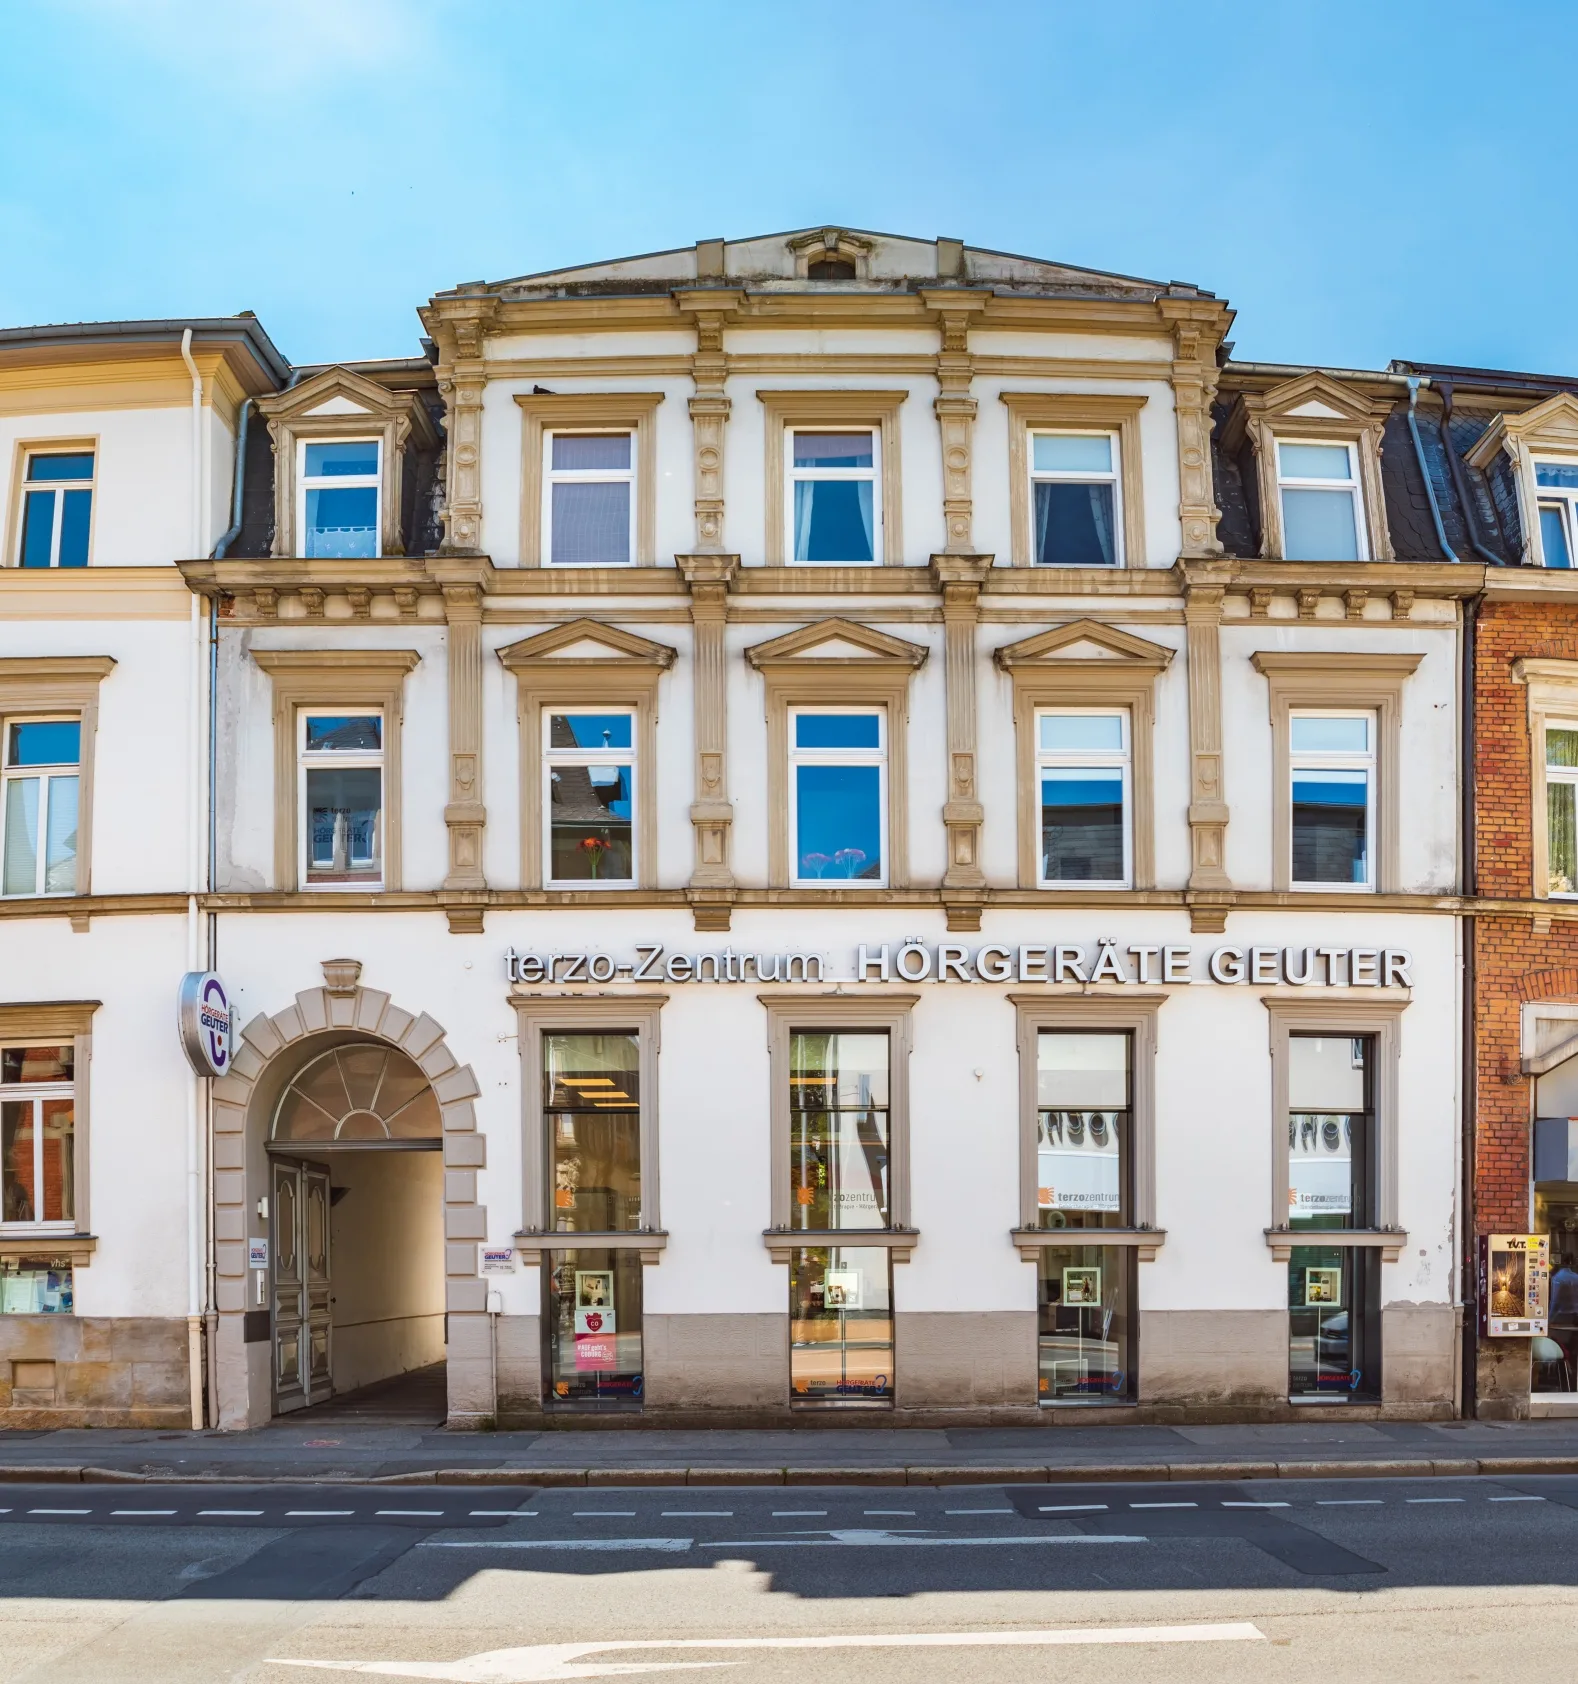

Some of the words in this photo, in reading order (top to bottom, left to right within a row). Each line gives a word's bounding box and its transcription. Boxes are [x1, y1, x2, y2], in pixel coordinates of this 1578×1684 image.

[504, 944, 825, 983] terzo-Zentrum
[858, 936, 1192, 983] HÖRGERÄTE
[1208, 945, 1415, 988] GEUTER
[201, 1004, 229, 1022] HÖRGERÄTE
[201, 1013, 229, 1034] GEUTER
[51, 1259, 66, 1268] vhs
